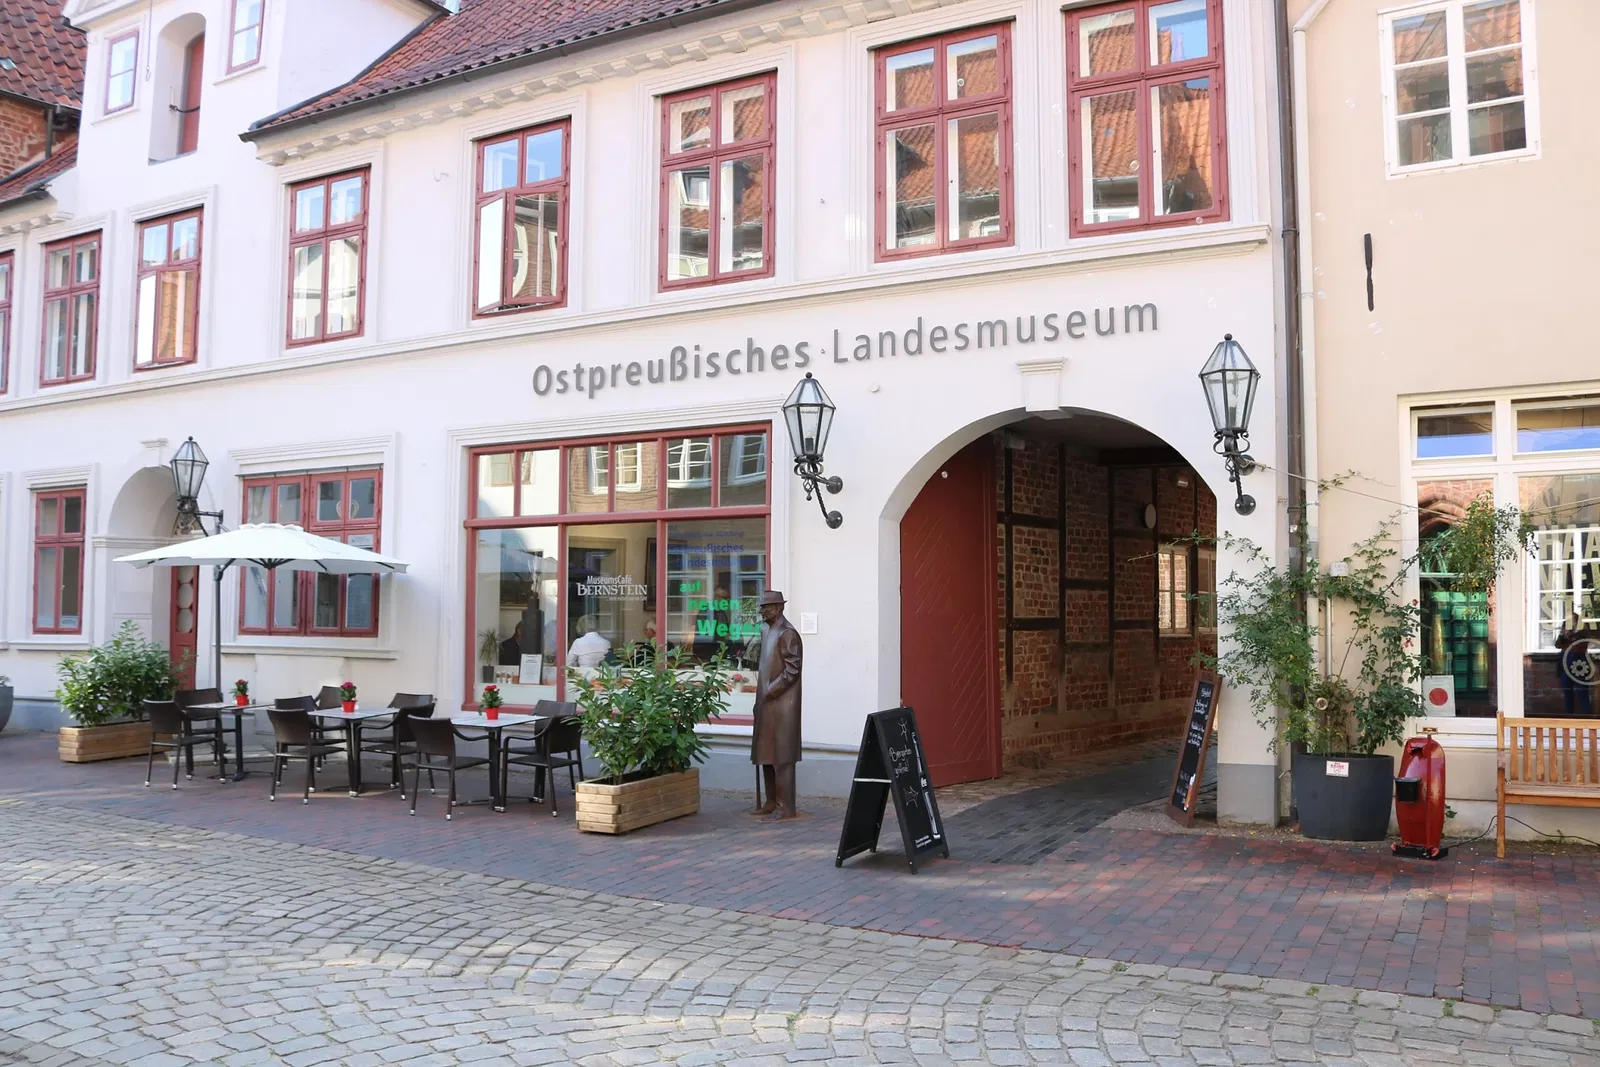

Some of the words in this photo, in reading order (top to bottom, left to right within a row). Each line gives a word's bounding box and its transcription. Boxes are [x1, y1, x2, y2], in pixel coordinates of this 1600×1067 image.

[532, 337, 810, 399] Ostpreußisches
[833, 303, 1158, 363] Landesmuseum
[586, 575, 632, 584] MuseumsCafé
[576, 583, 647, 596] BERNSTEIN
[680, 580, 700, 592] auf
[687, 598, 740, 610] neuen
